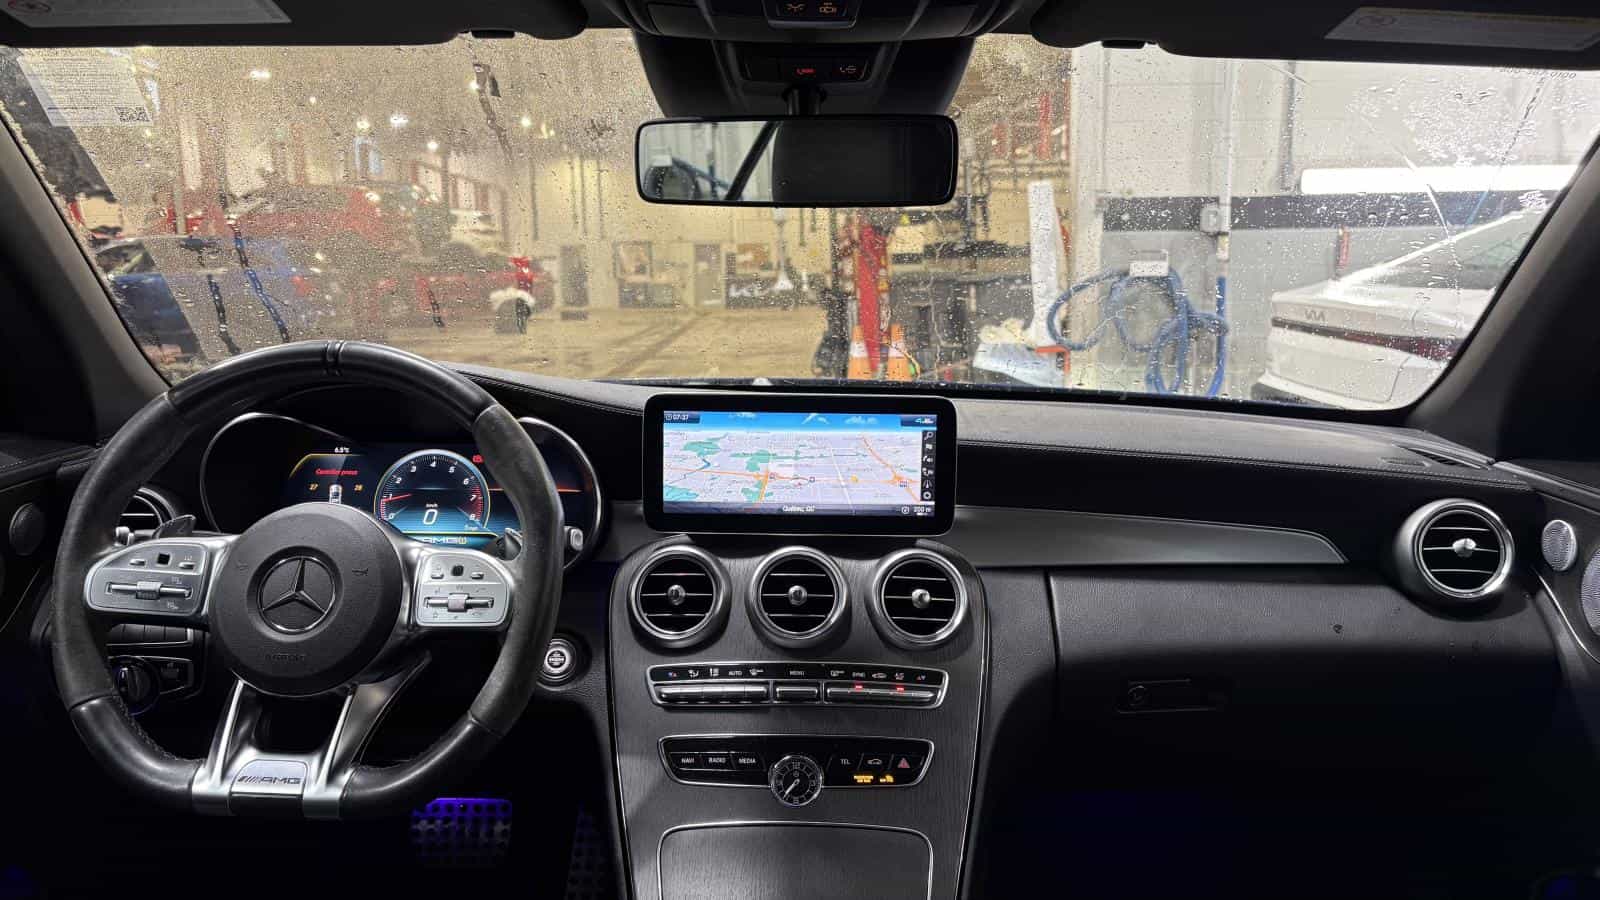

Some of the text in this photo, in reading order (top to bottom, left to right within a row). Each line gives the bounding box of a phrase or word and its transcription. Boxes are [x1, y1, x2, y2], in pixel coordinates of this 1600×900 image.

[410, 465, 417, 473] 3
[448, 465, 456, 473] 5
[469, 494, 477, 502] 7
[423, 508, 438, 525] 0
[840, 758, 851, 766] TEL
[258, 776, 302, 785] AMG
